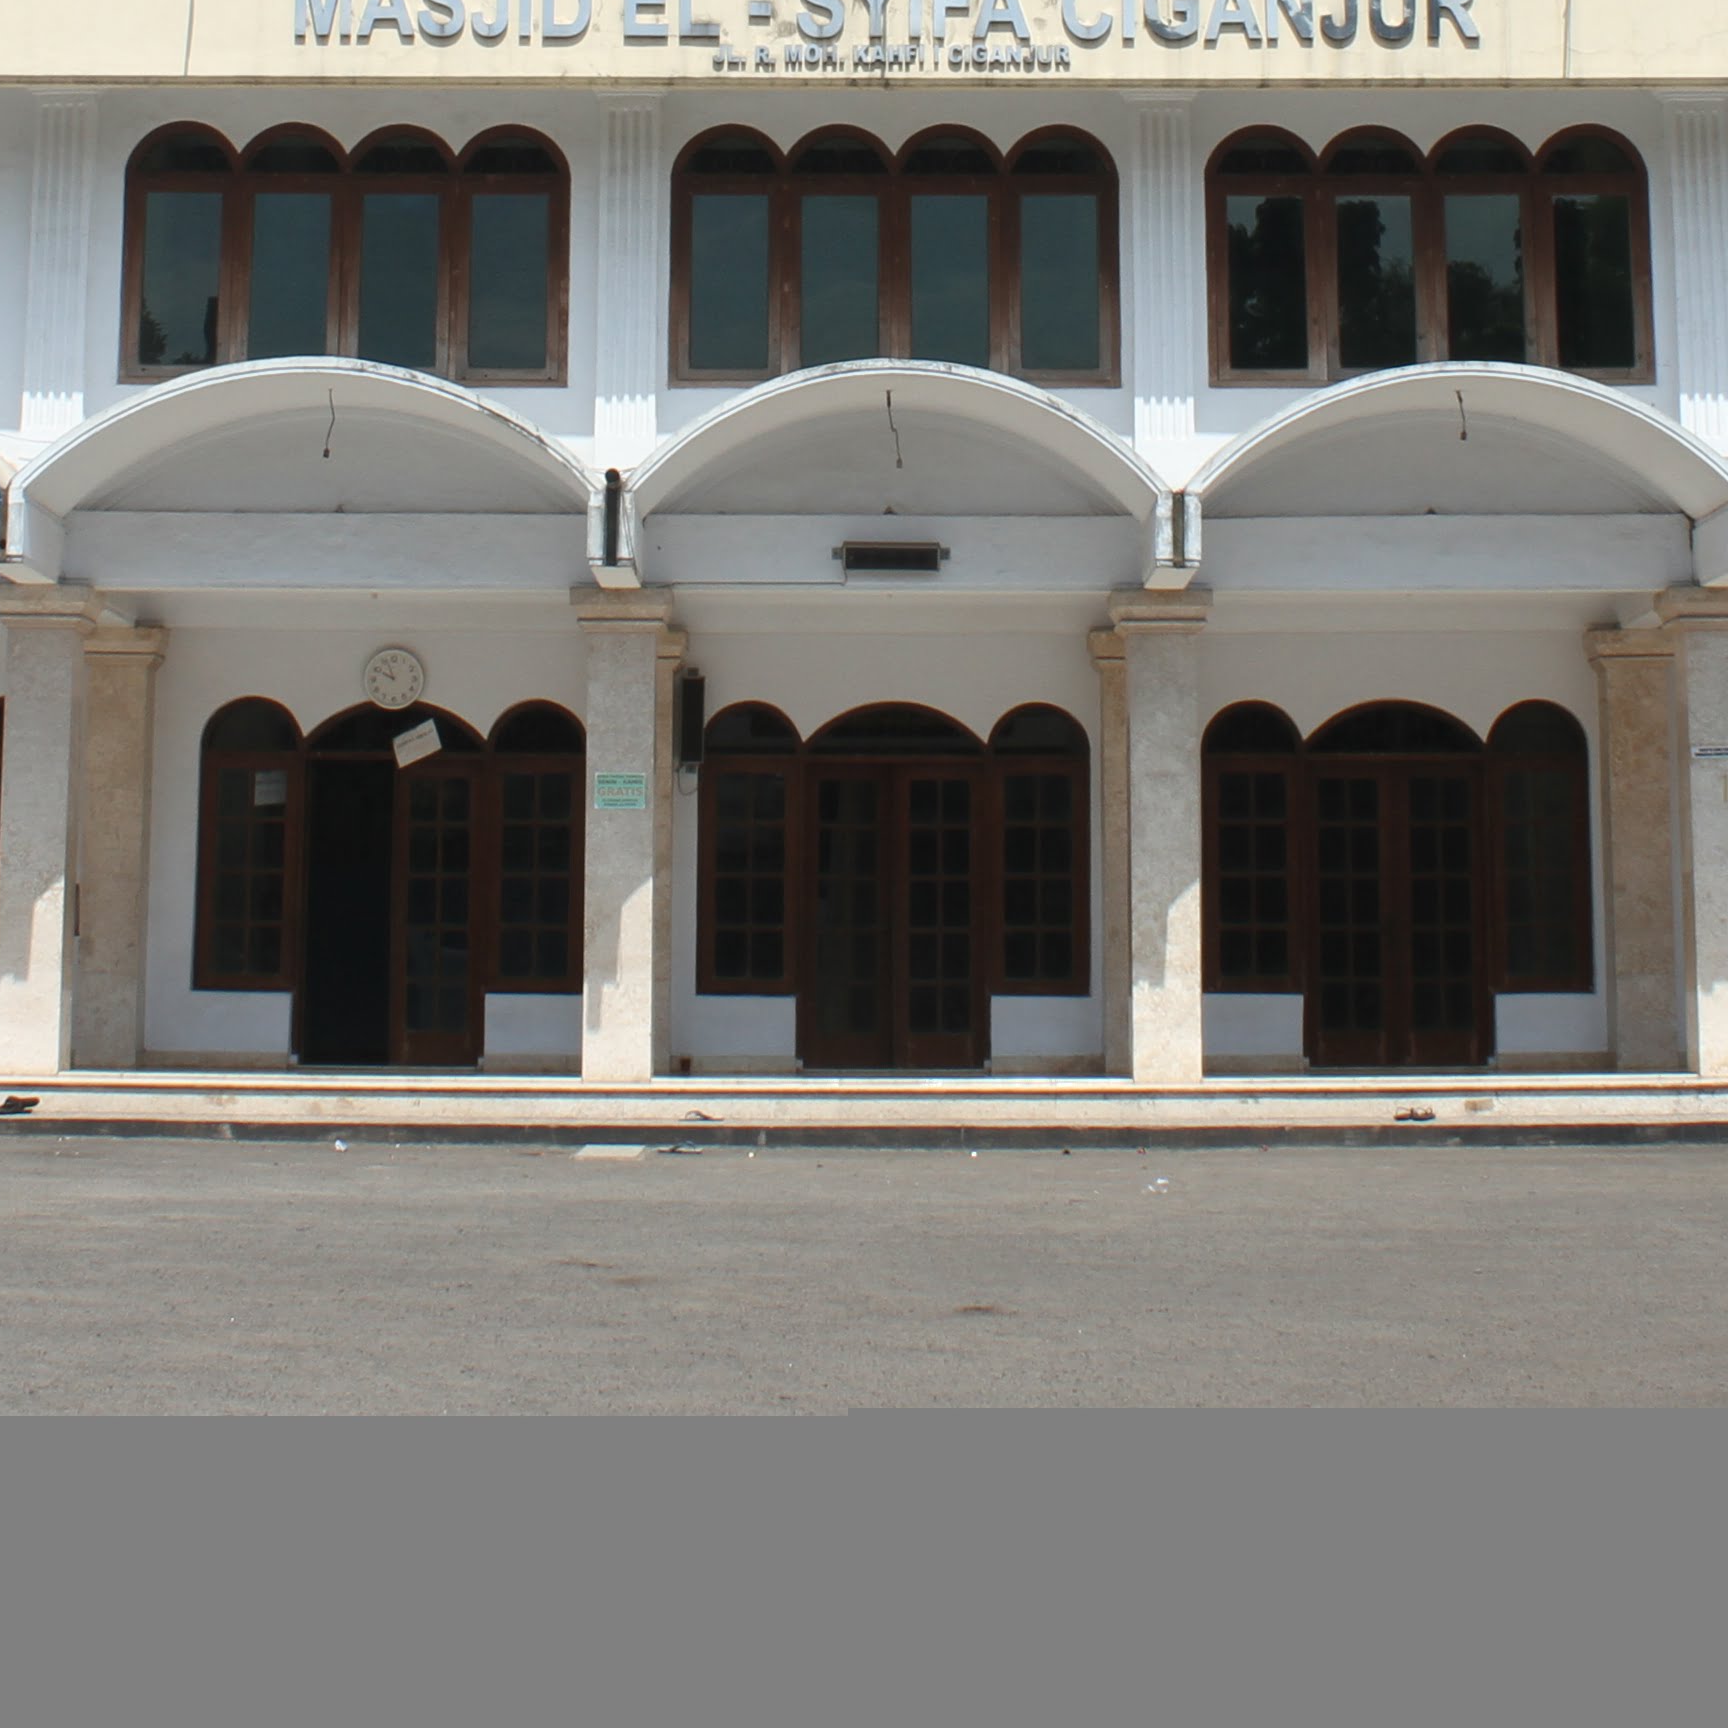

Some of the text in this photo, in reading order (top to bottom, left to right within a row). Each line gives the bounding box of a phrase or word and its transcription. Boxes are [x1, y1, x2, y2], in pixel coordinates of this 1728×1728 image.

[712, 44, 747, 66] JL.
[754, 44, 775, 66] R.
[784, 44, 846, 66] MOH.
[853, 44, 926, 66] KAHFI
[947, 44, 1071, 66] CIGANJUR
[597, 786, 644, 797] GRATIS
